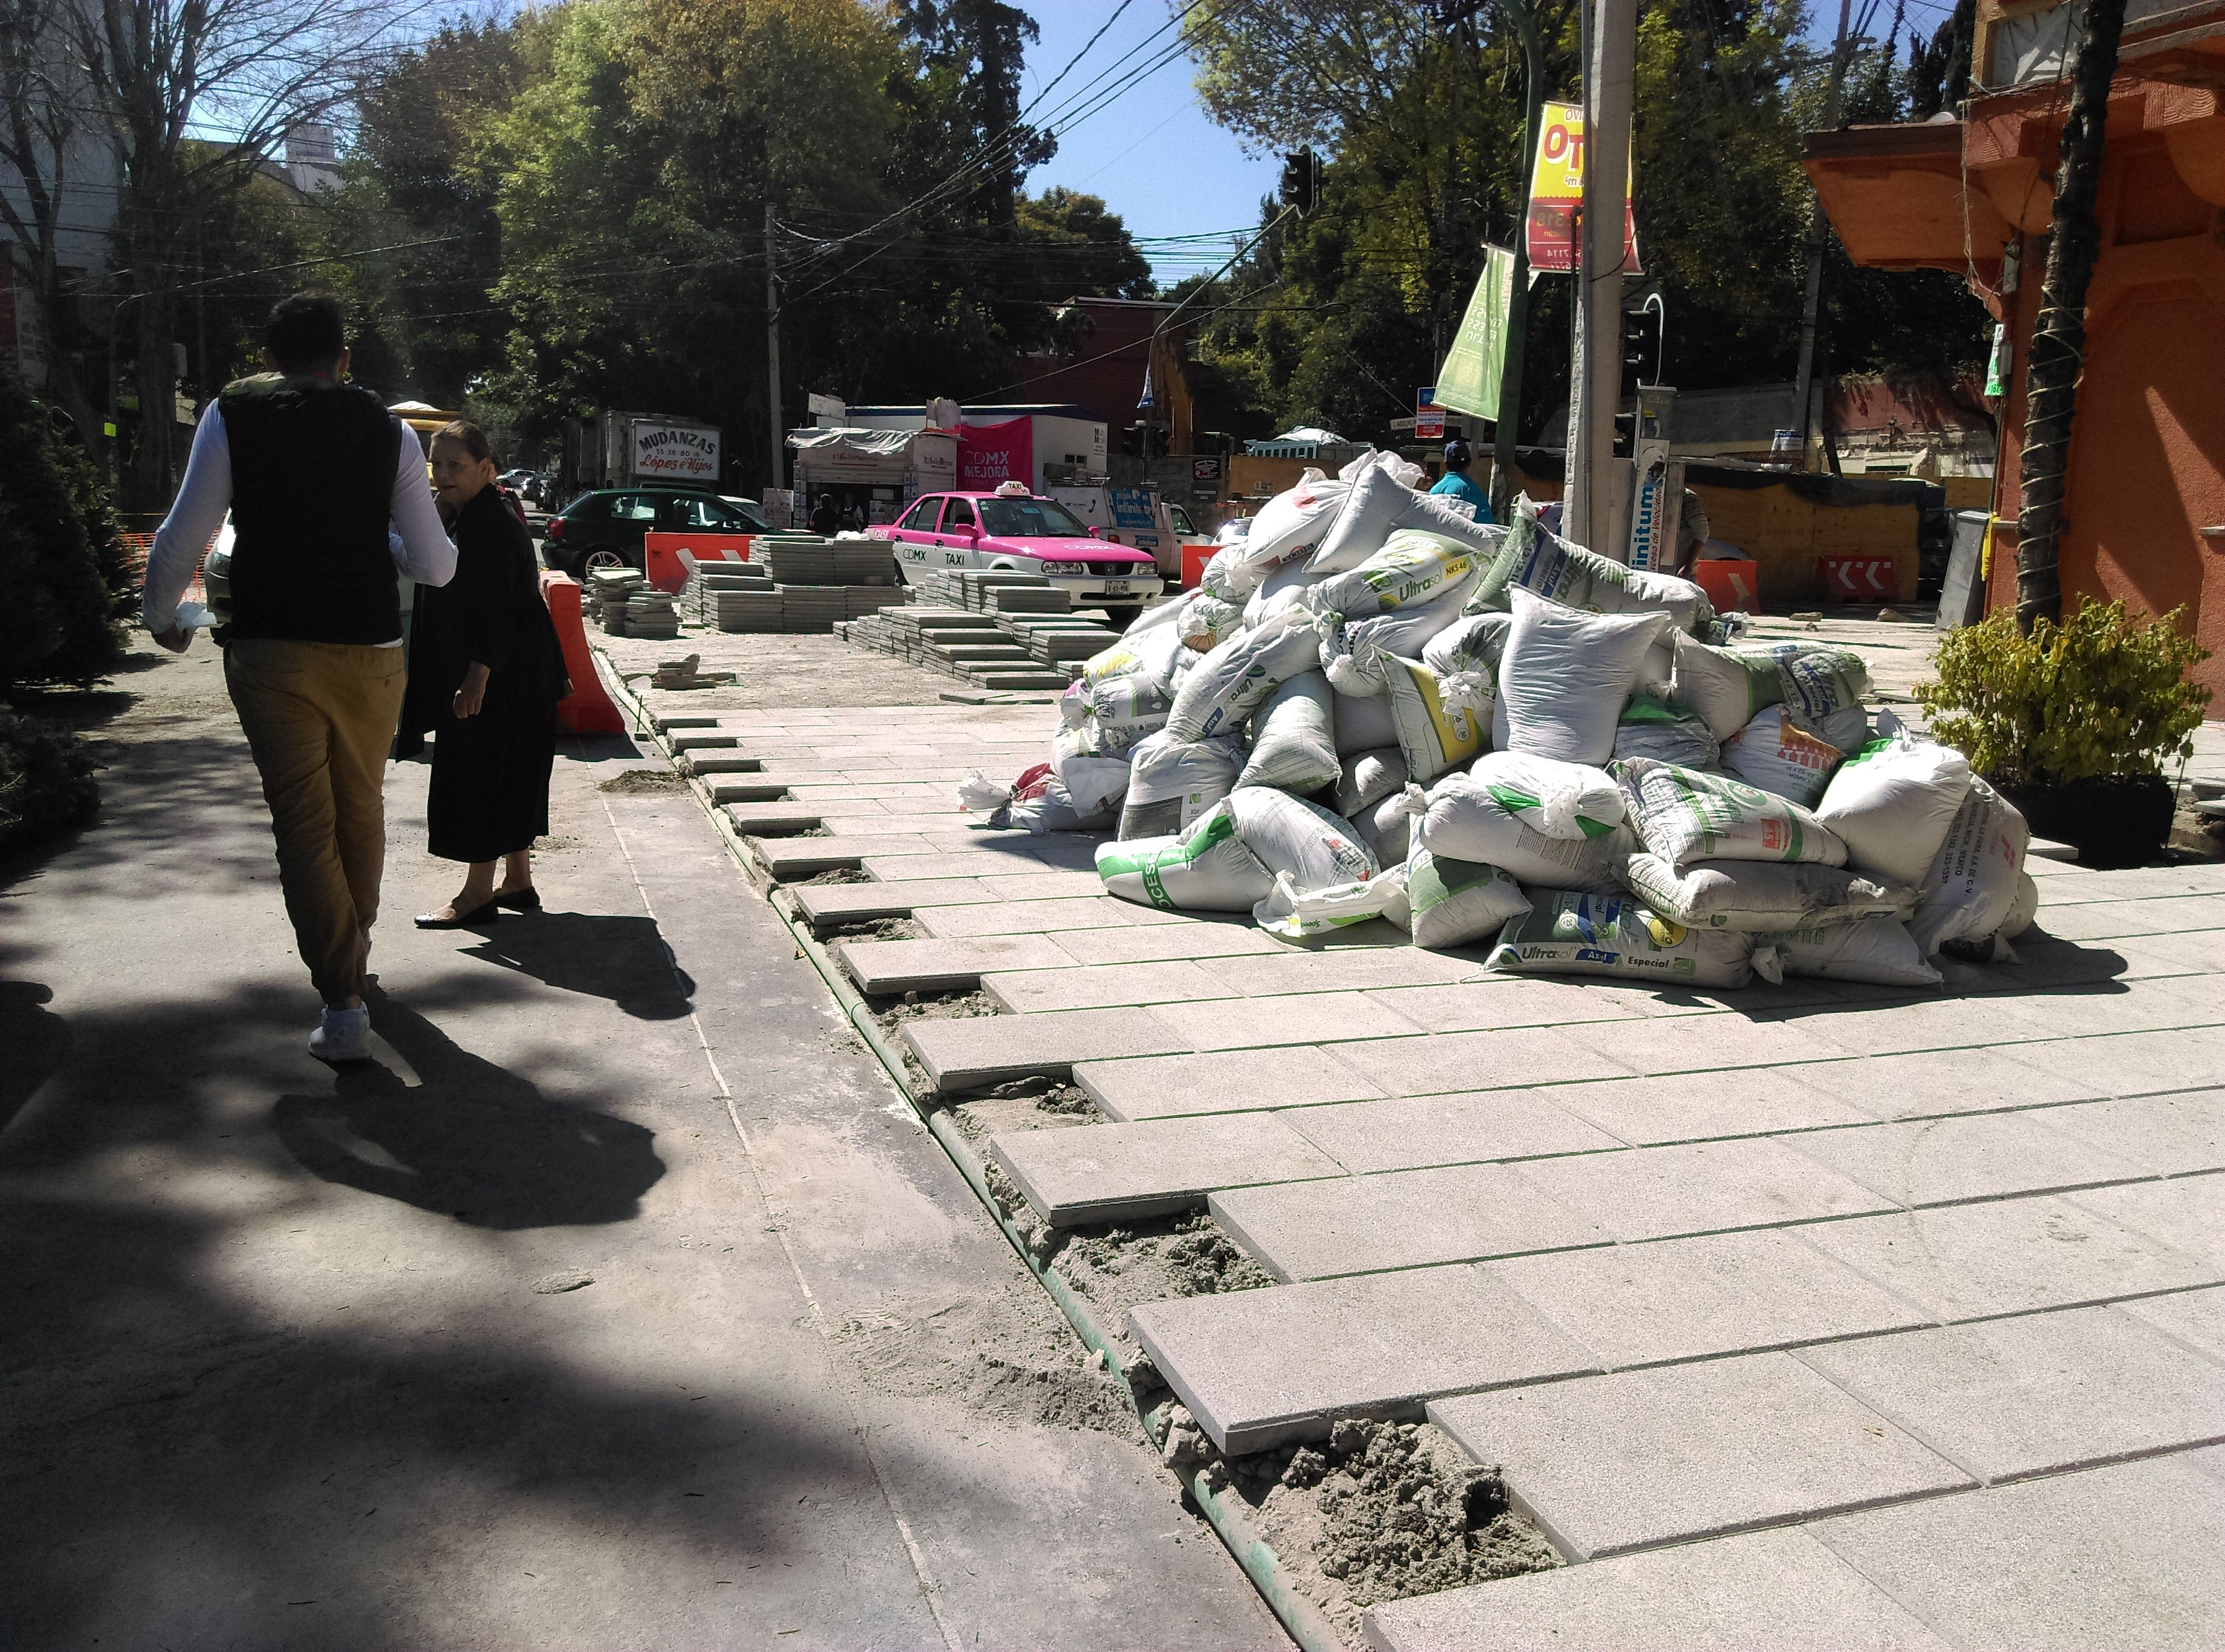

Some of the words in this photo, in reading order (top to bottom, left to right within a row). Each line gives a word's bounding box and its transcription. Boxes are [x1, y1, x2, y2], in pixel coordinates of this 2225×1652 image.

[638, 431, 716, 454] MUDANZAS
[640, 454, 678, 472] López
[964, 450, 1010, 465] CDMX
[964, 466, 1009, 478] MEJORA
[1652, 487, 1662, 530] Velocidad
[1651, 533, 1658, 544] de
[903, 548, 927, 561] CDMX
[945, 553, 964, 566] TAXI
[1649, 546, 1658, 572] xceso
[1399, 566, 1442, 602] Ultrasol
[1446, 564, 1459, 575] NKS
[1955, 850, 1967, 876] MEXICO
[1968, 869, 1976, 878] DE
[1965, 879, 1974, 896] C.V.
[1521, 947, 1572, 959] Ultrasol
[1588, 951, 1607, 961] Azul
[1628, 957, 1669, 968] Especial
